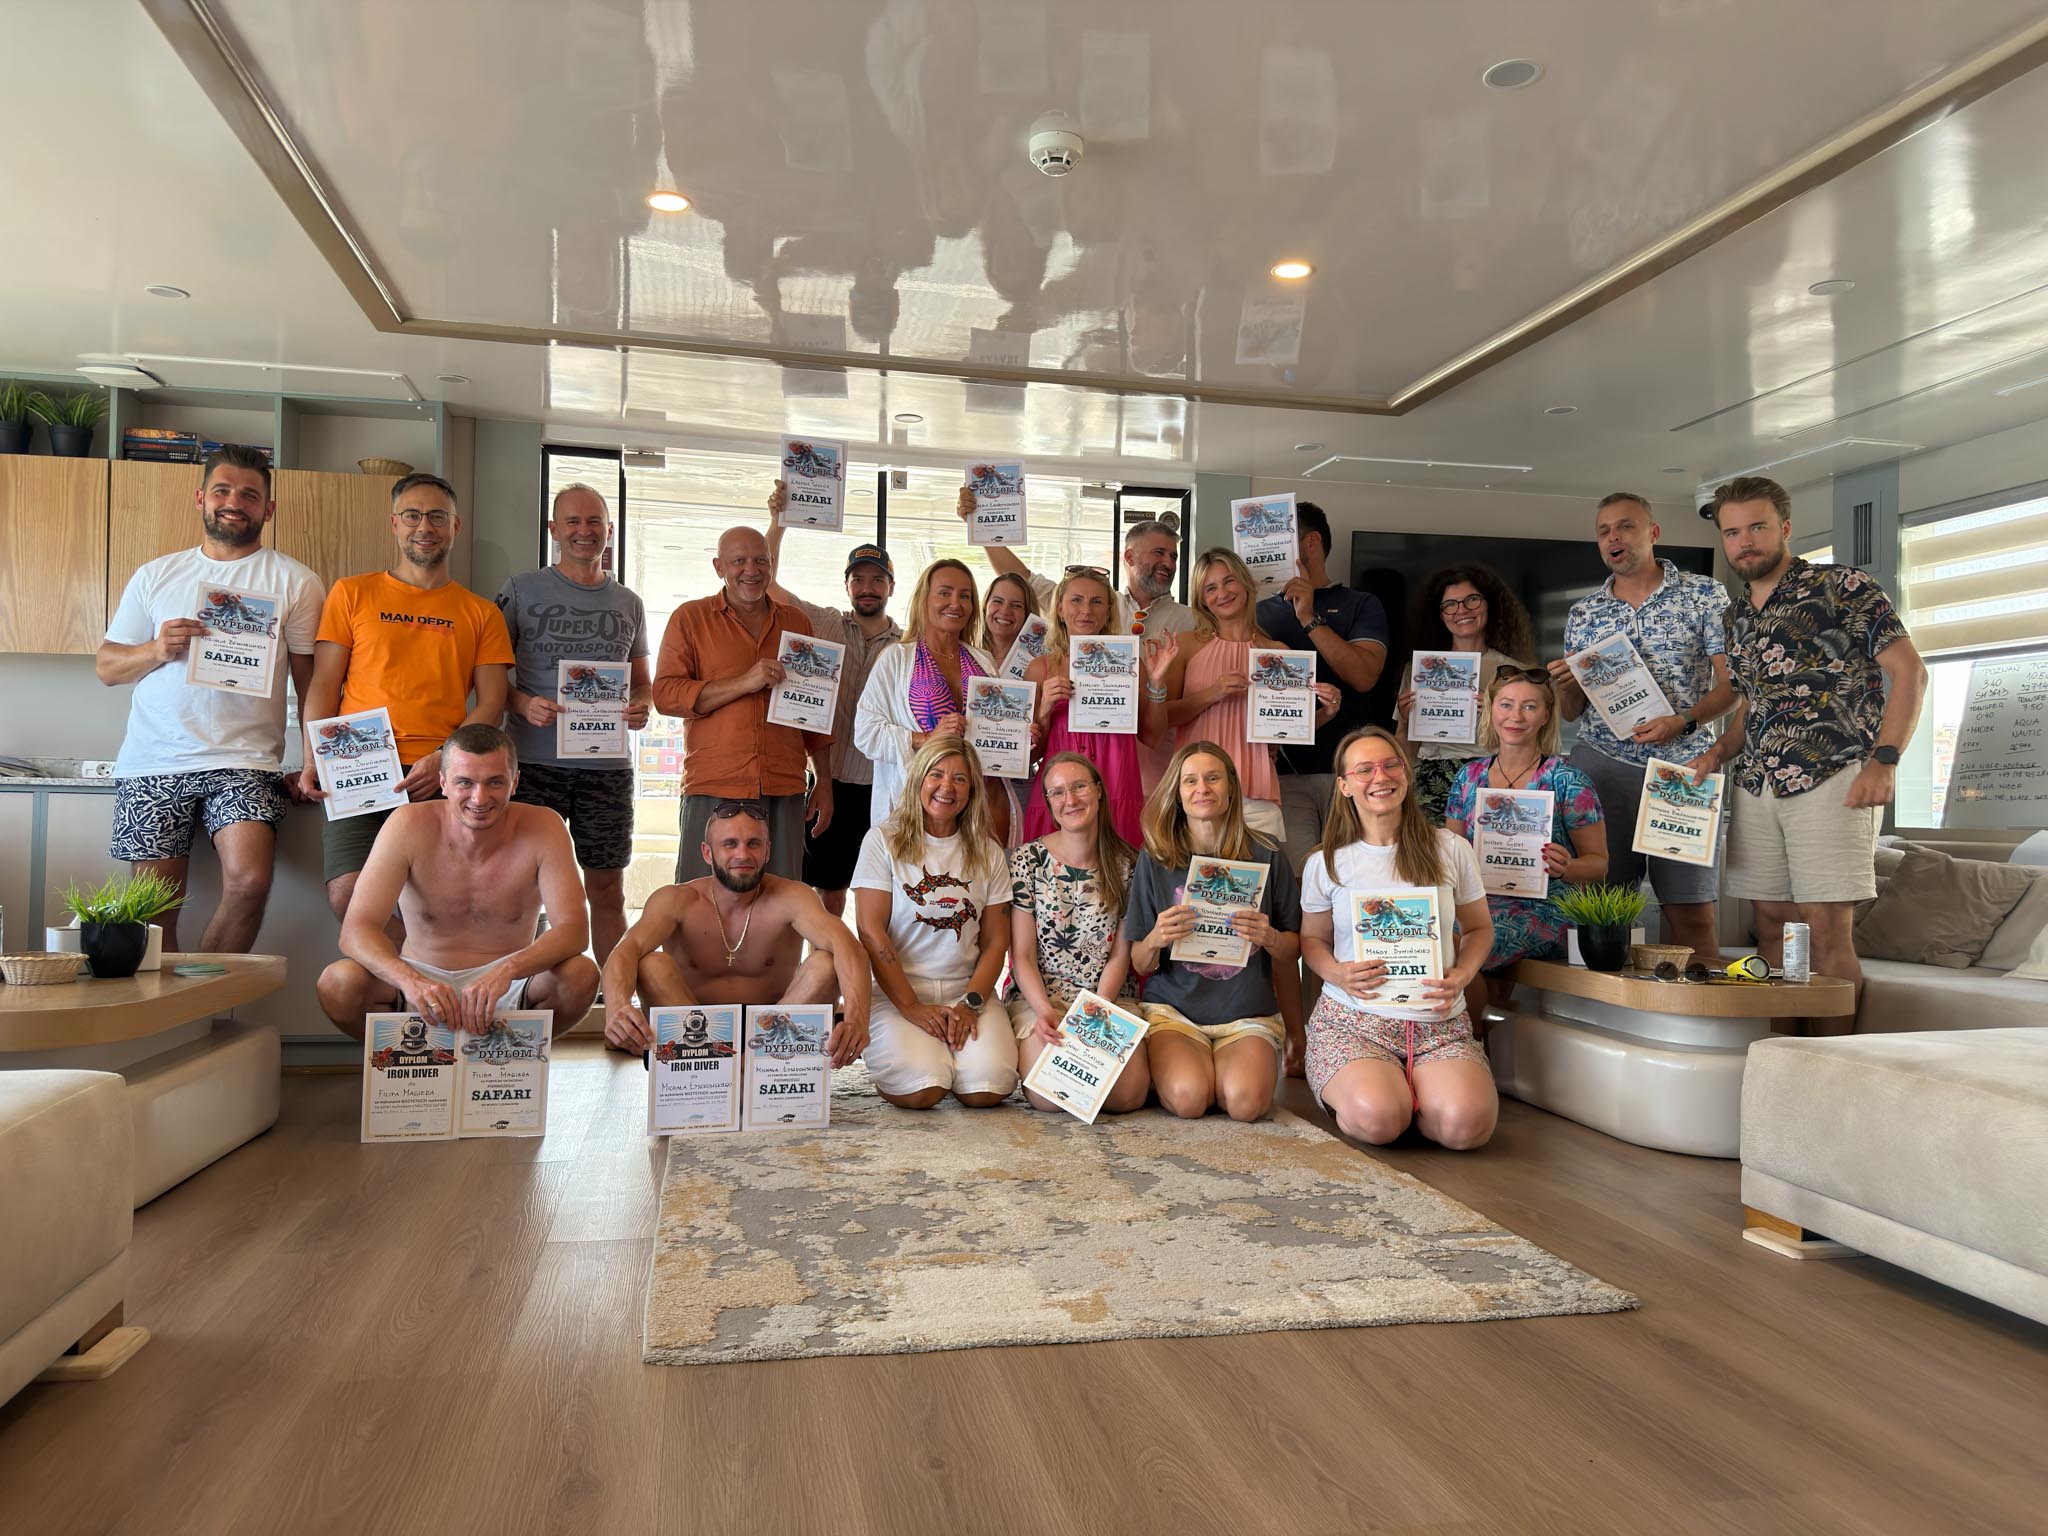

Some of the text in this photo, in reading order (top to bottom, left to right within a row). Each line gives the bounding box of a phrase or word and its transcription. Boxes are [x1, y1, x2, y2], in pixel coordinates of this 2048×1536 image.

[792, 493, 832, 504] SAFARI
[977, 515, 1016, 523] SAFARI
[1246, 553, 1287, 564] SAFARI
[380, 612, 413, 622] MAN
[212, 618, 262, 632] DYPLOM
[204, 651, 259, 667] SAFARI
[783, 691, 824, 706] SAFARI
[1081, 697, 1126, 705] SAFARI
[1608, 688, 1649, 714] SAFARI
[981, 708, 1020, 718] DYPLOM
[1260, 708, 1303, 717] SAFARI
[1421, 708, 1464, 717] SAFARI
[570, 722, 616, 730] SAFARI
[2014, 718, 2040, 728] AQUA
[2012, 729, 2042, 738] NAUTIC
[332, 742, 380, 756] DYPLOM
[976, 739, 1018, 750] SAFARI
[336, 772, 389, 789] SAFARI
[1660, 791, 1704, 807] DYPLOM
[1491, 822, 1536, 831] DYPLOM
[1650, 820, 1701, 836] SAFARI
[1486, 855, 1536, 867] SAFARI
[1201, 891, 1248, 902] DYPLOM
[1195, 924, 1238, 936] AFAR
[1372, 928, 1422, 937] DYPLOM
[1386, 965, 1427, 975] FARI
[1075, 1026, 1118, 1056] DYPLOM
[765, 1044, 815, 1052] DYPLOM
[480, 1050, 532, 1059] DYPLOM
[671, 1061, 719, 1072] IRON DIVER
[1052, 1055, 1100, 1087] SAFARI
[388, 1068, 439, 1078] IRON DIVER
[760, 1083, 815, 1094] SAFARI
[472, 1089, 532, 1101] SAFARI
